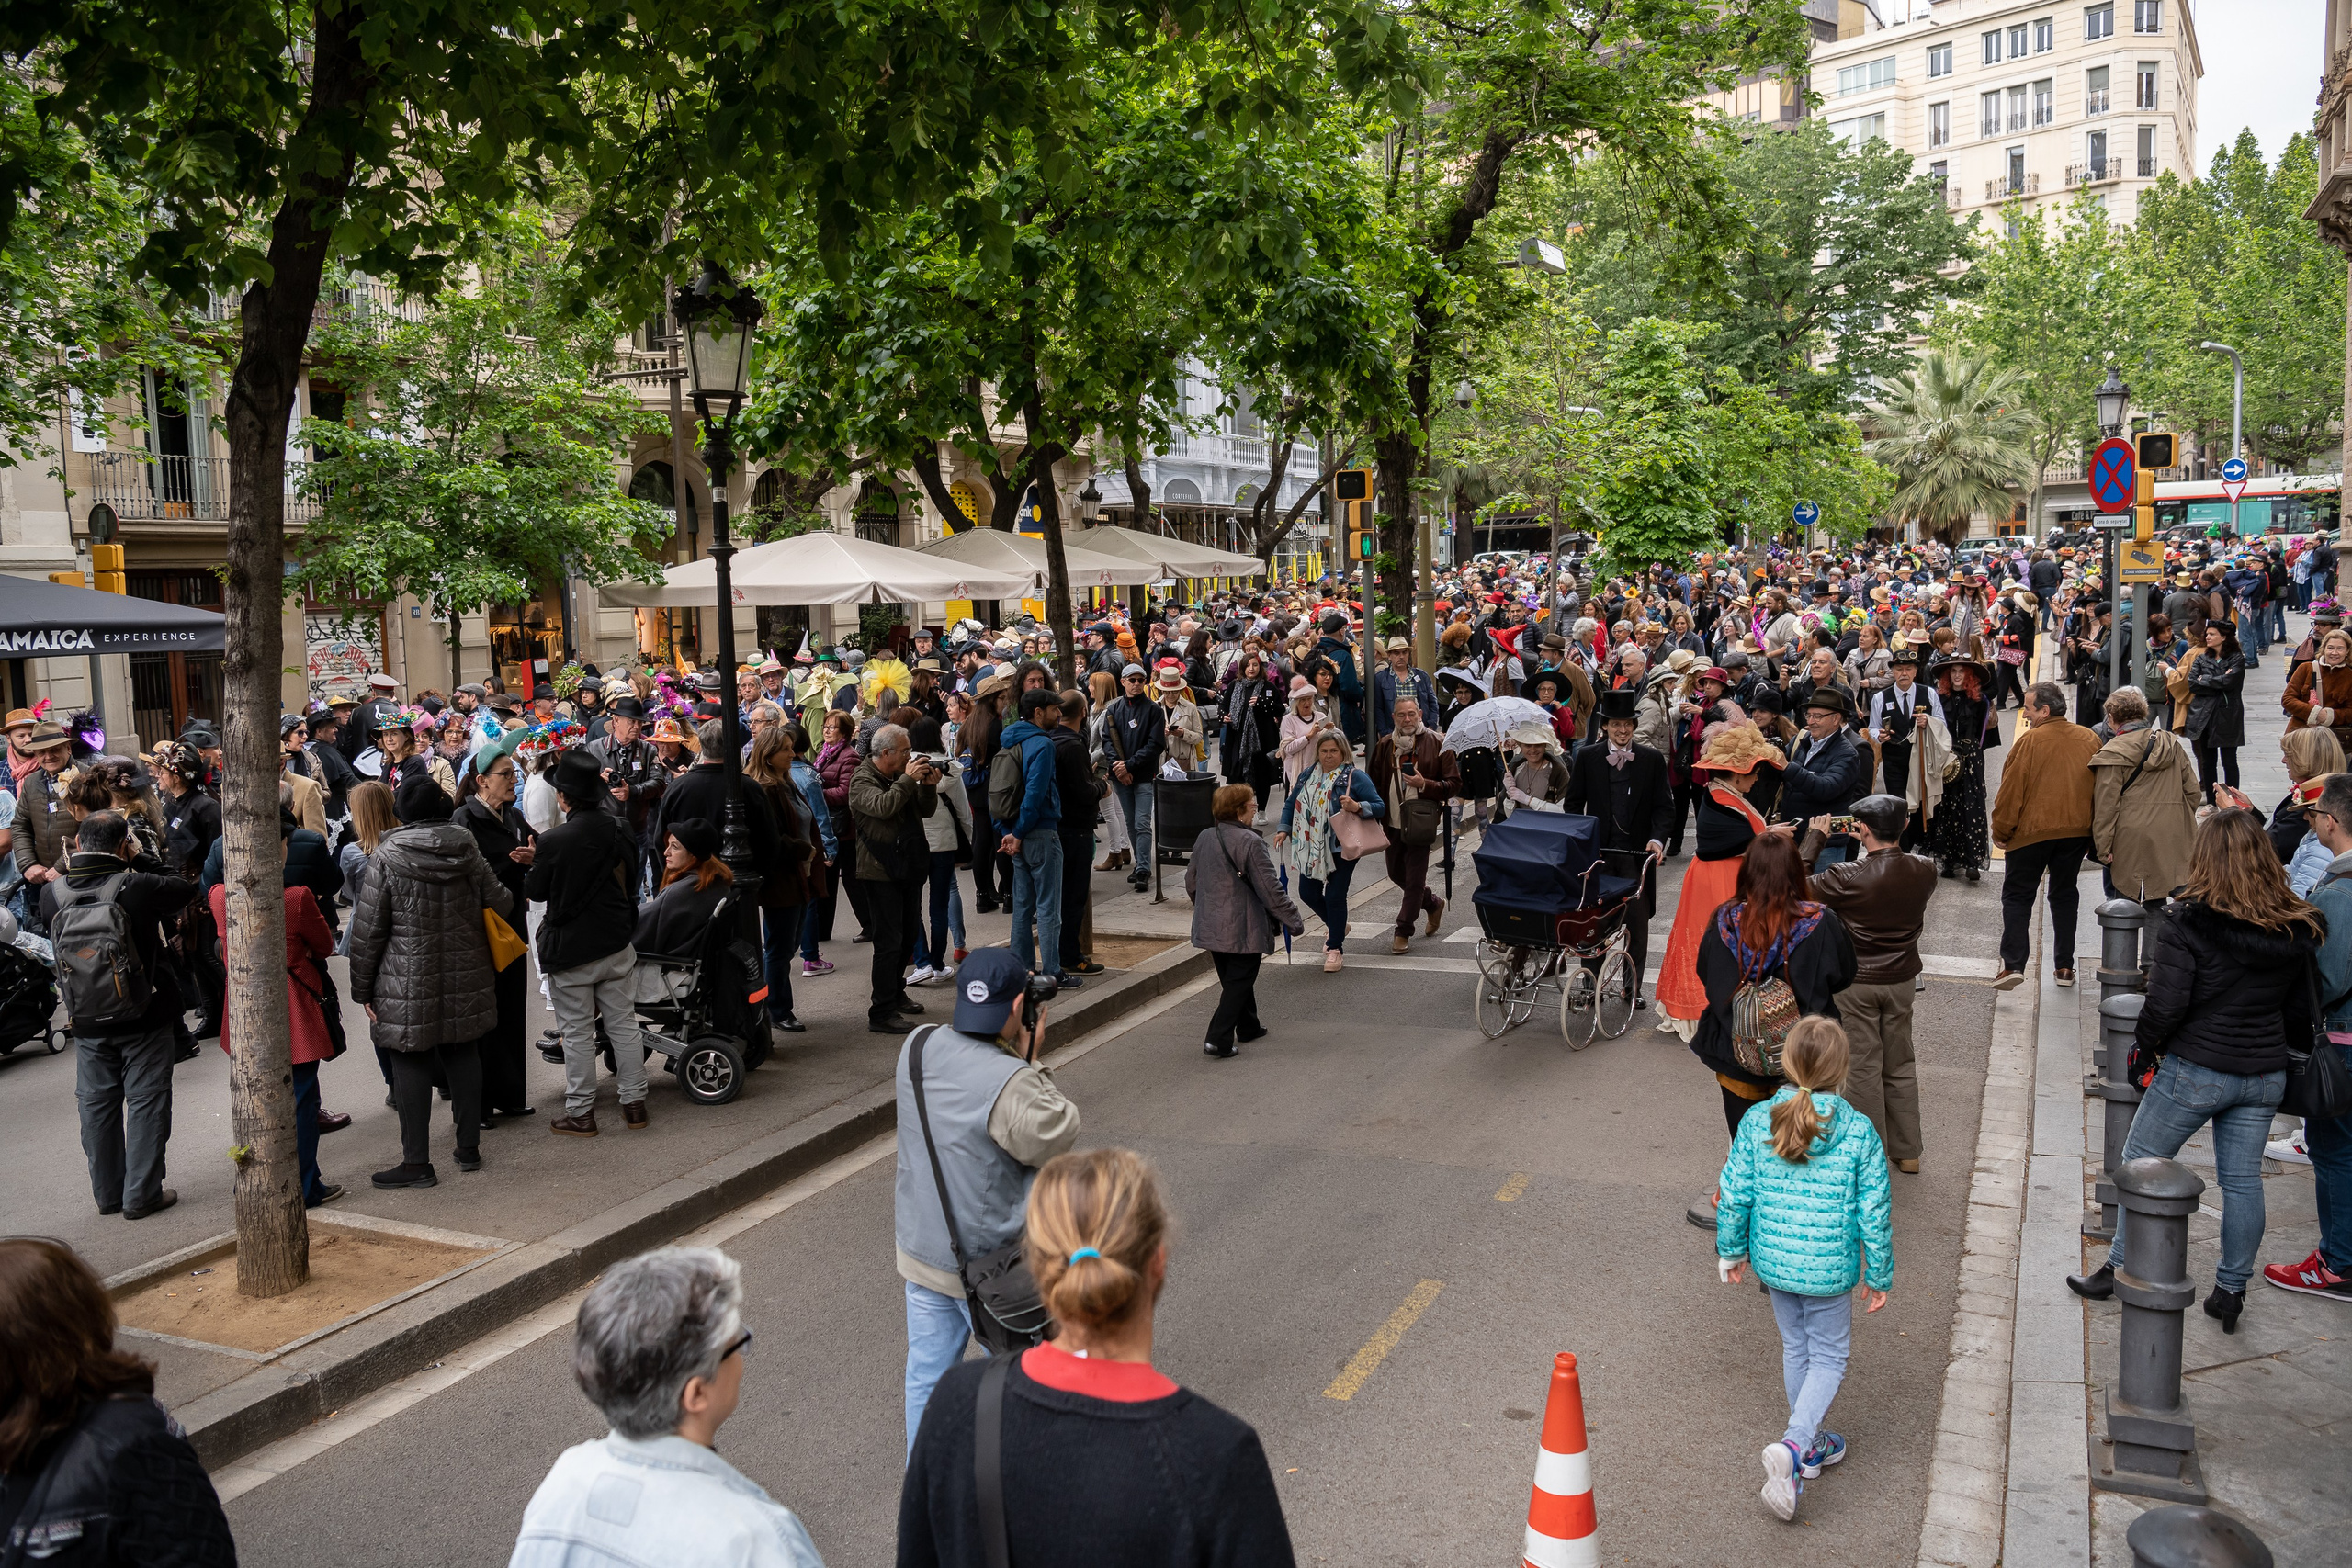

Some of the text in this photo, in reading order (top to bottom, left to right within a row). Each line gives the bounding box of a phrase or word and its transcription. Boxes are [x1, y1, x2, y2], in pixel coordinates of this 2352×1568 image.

[2071, 511, 2084, 521] Café
[104, 632, 196, 642] EXPERIENCE
[2299, 1270, 2323, 1286] N
